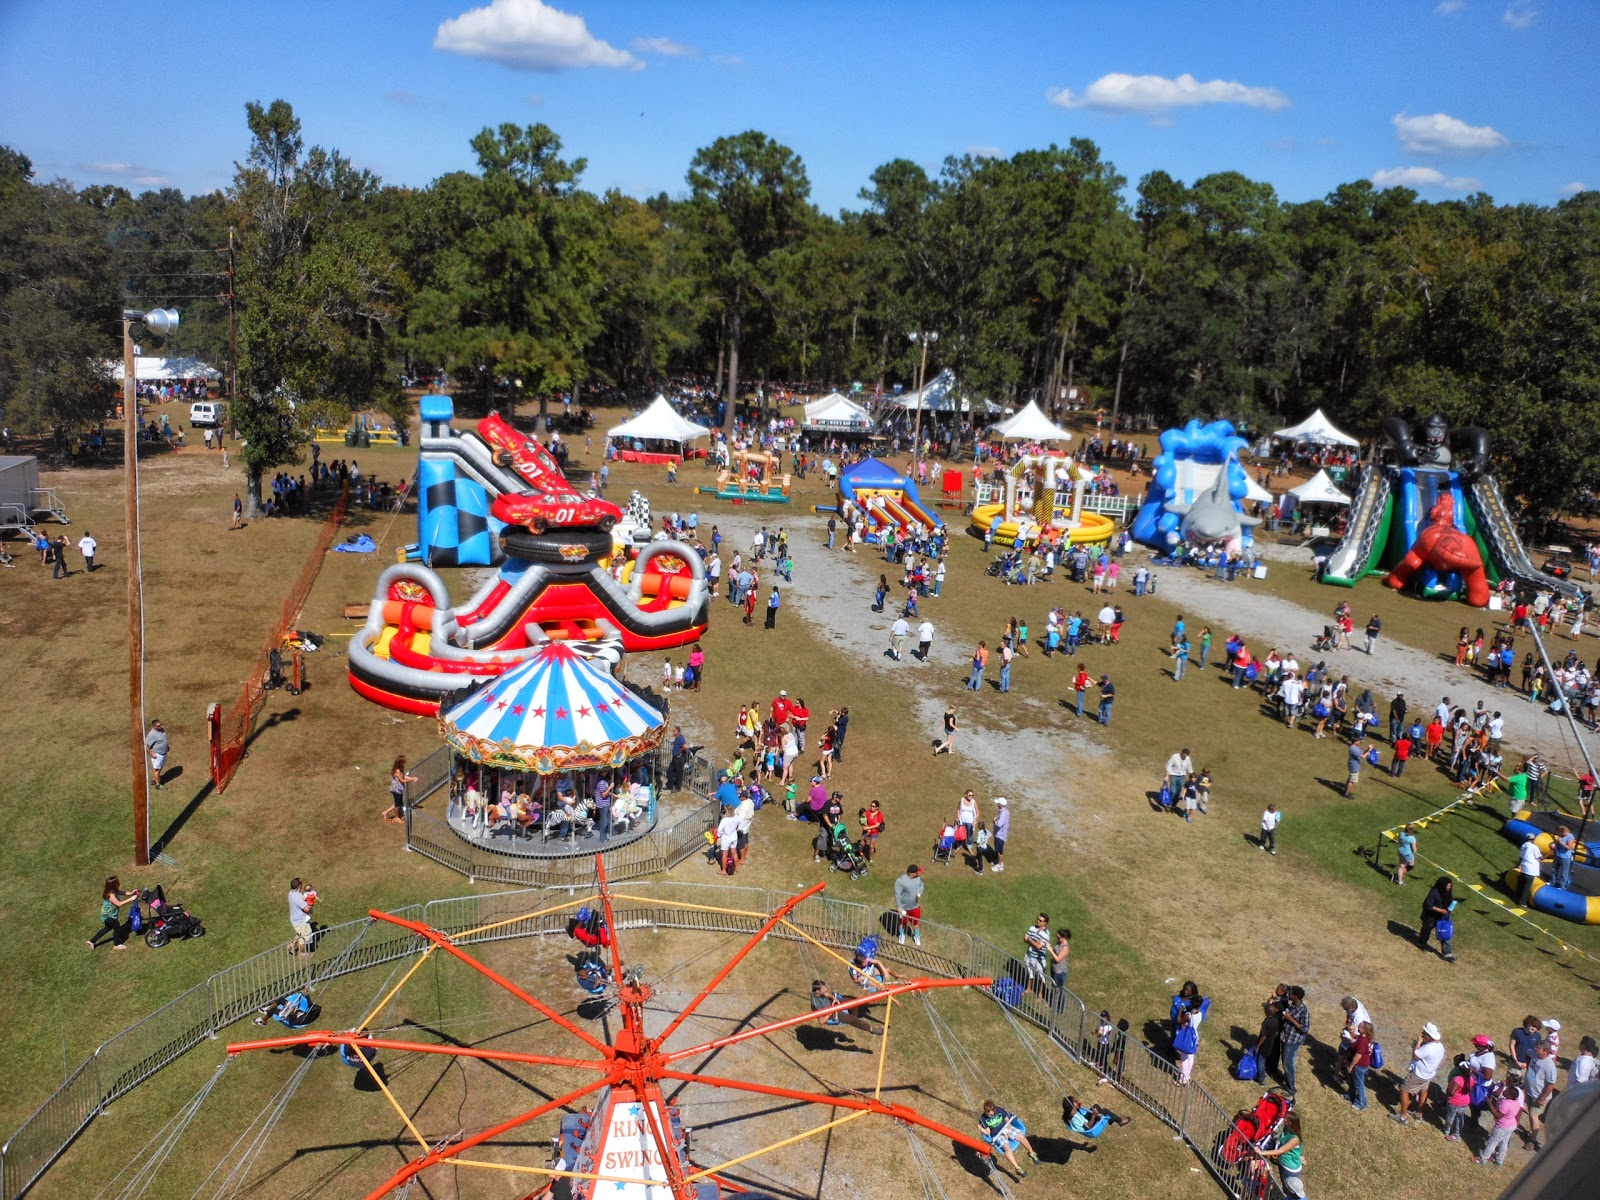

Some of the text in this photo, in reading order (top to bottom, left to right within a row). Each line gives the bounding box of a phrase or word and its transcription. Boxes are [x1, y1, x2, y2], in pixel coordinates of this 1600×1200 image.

[520, 462, 543, 478] 01
[555, 508, 576, 523] 01
[1483, 484, 1517, 554] KONGO KRAZY
